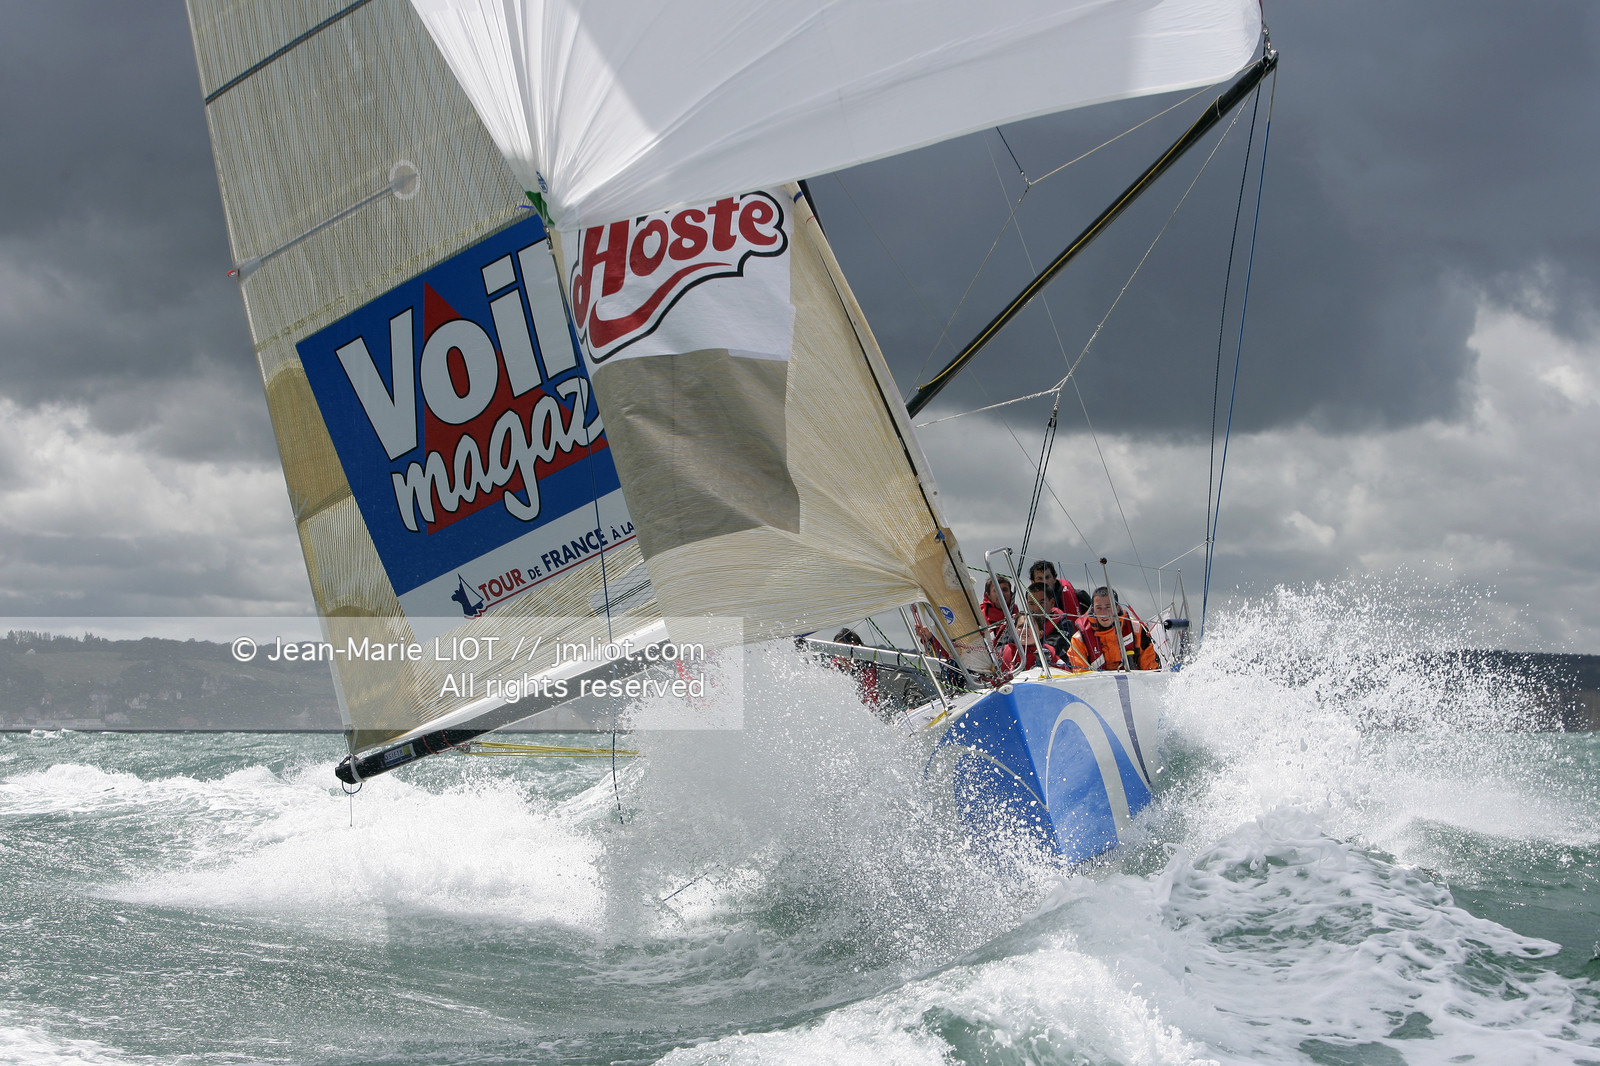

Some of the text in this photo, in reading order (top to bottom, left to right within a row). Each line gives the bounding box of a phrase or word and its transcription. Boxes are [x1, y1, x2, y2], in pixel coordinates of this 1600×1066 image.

[478, 521, 635, 601] TOUR DE FRANCE À LA
